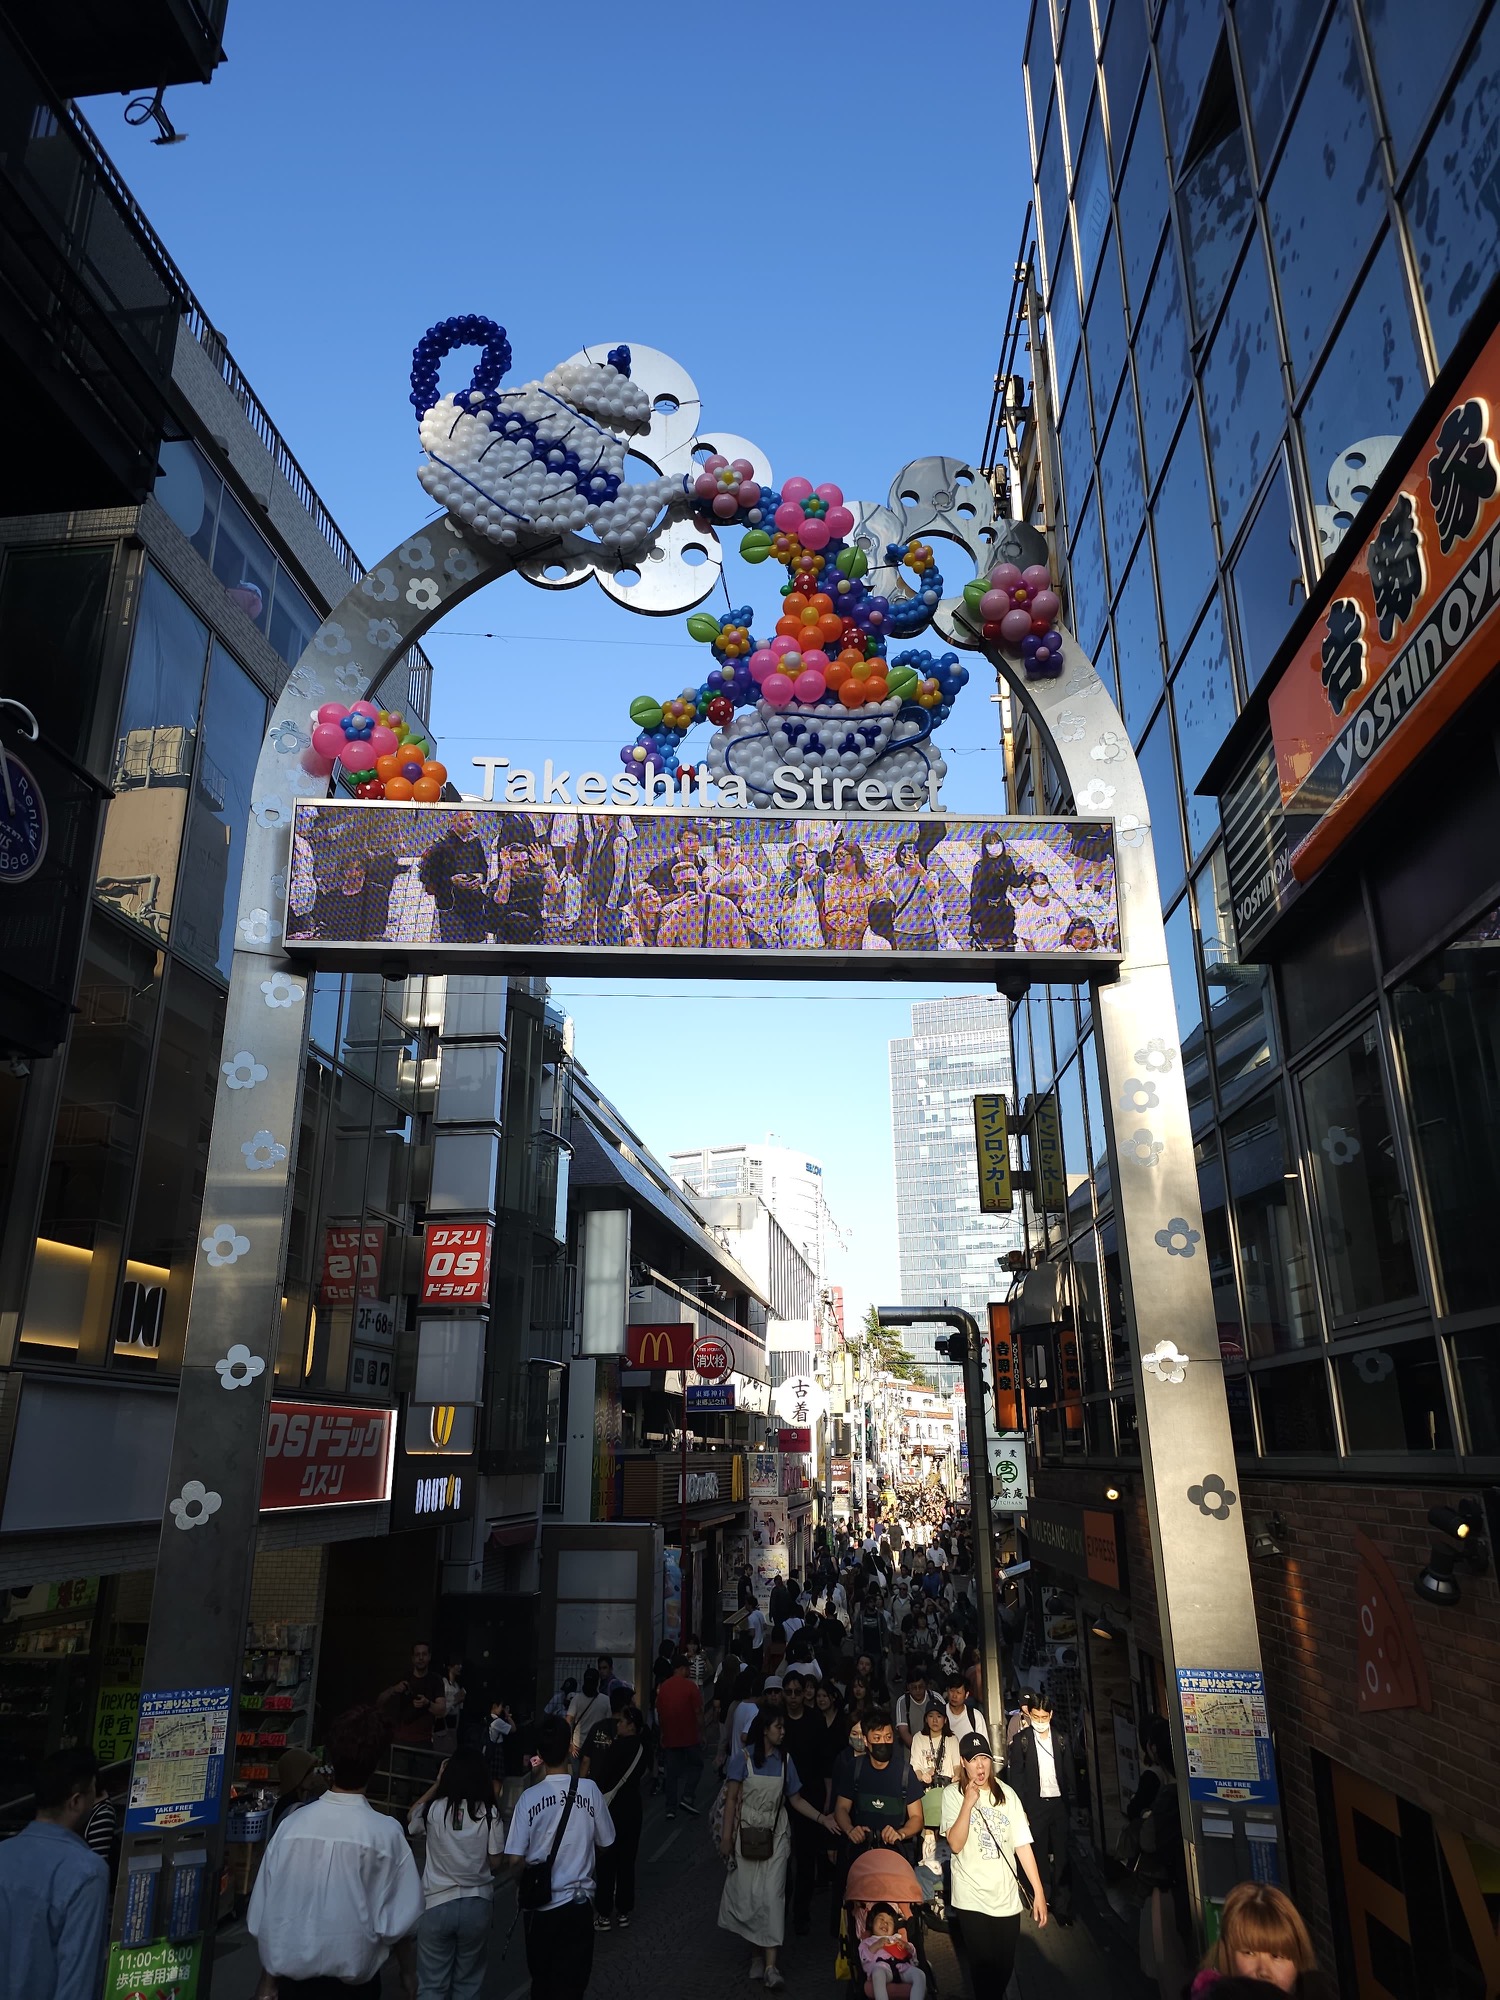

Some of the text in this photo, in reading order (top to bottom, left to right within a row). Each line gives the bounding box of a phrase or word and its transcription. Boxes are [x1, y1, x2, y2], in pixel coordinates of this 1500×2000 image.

[472, 756, 948, 812] Takeshita Street
[18, 776, 40, 851] Rental
[981, 1097, 1006, 1196] コインロッカー
[986, 1198, 1009, 1208] 3F
[431, 1230, 482, 1246] クスリ
[427, 1252, 482, 1277] OS
[425, 1282, 481, 1297] ドラッグ
[696, 1353, 725, 1368] 消火栓
[1012, 1342, 1021, 1390] YOSHINOYA
[792, 1380, 809, 1422] 古着
[265, 1412, 386, 1458] OSドラッグ
[299, 1465, 346, 1497] クスリ
[414, 1473, 462, 1515] DOUTOR
[1086, 1535, 1115, 1564] EXPRESS
[98, 1714, 133, 1736] 便宜
[1213, 1779, 1233, 1787] TAKE
[154, 1804, 194, 1814] TAKE FREE
[116, 1964, 191, 1990] 歩行者用道路
